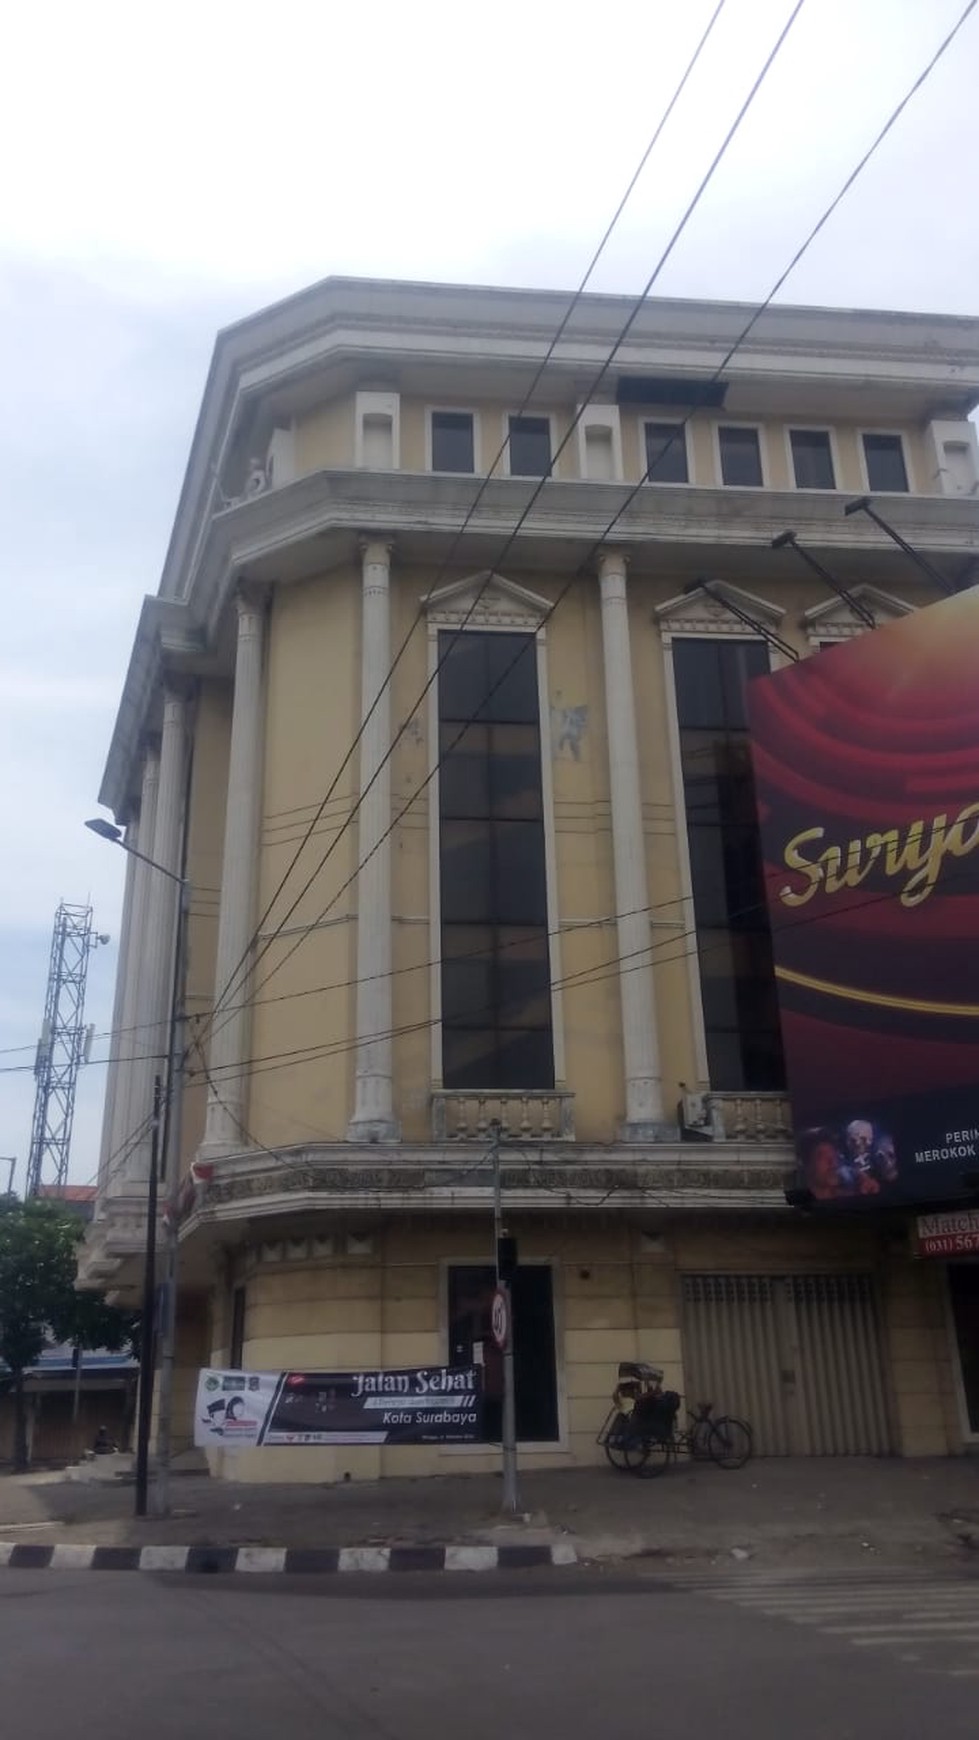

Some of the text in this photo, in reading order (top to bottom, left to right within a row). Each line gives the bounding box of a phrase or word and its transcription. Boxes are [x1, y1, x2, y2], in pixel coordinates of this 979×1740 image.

[915, 1144, 976, 1163] MEROKOK
[351, 1369, 477, 1397] Jalan Sehat
[383, 1411, 477, 1425] Kota Surabaya
